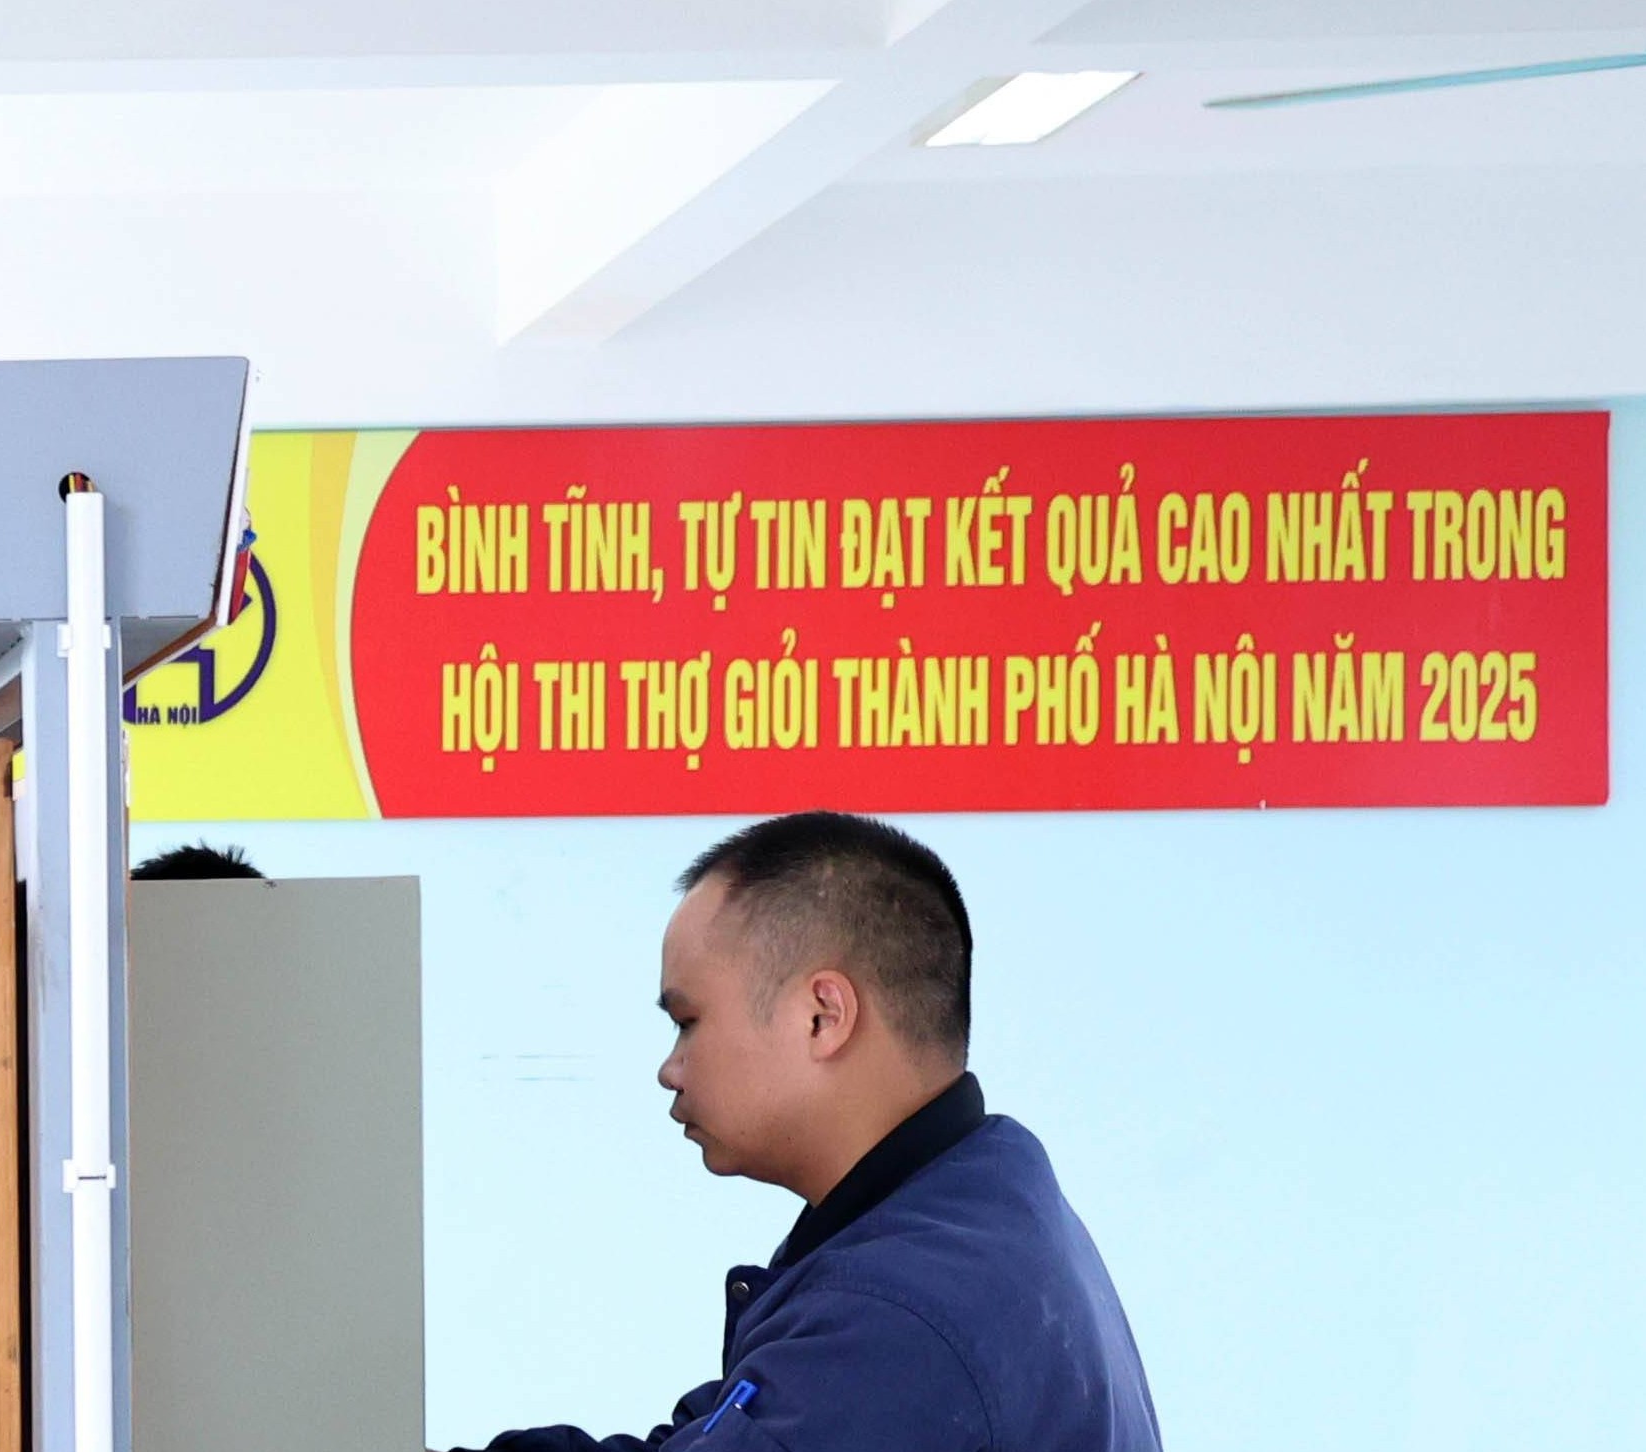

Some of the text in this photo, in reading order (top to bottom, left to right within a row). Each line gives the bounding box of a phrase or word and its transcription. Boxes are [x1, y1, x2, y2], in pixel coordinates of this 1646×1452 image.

[416, 458, 1565, 611] BÌNH TĨNH, TỰ TIN ĐẠT KẾT QUẢ CAO NHẤT TRONG
[442, 621, 1537, 772] HỘI THI THỢ GIỎI THÀNH PHỐ HÀ NỘI NĂM 2025
